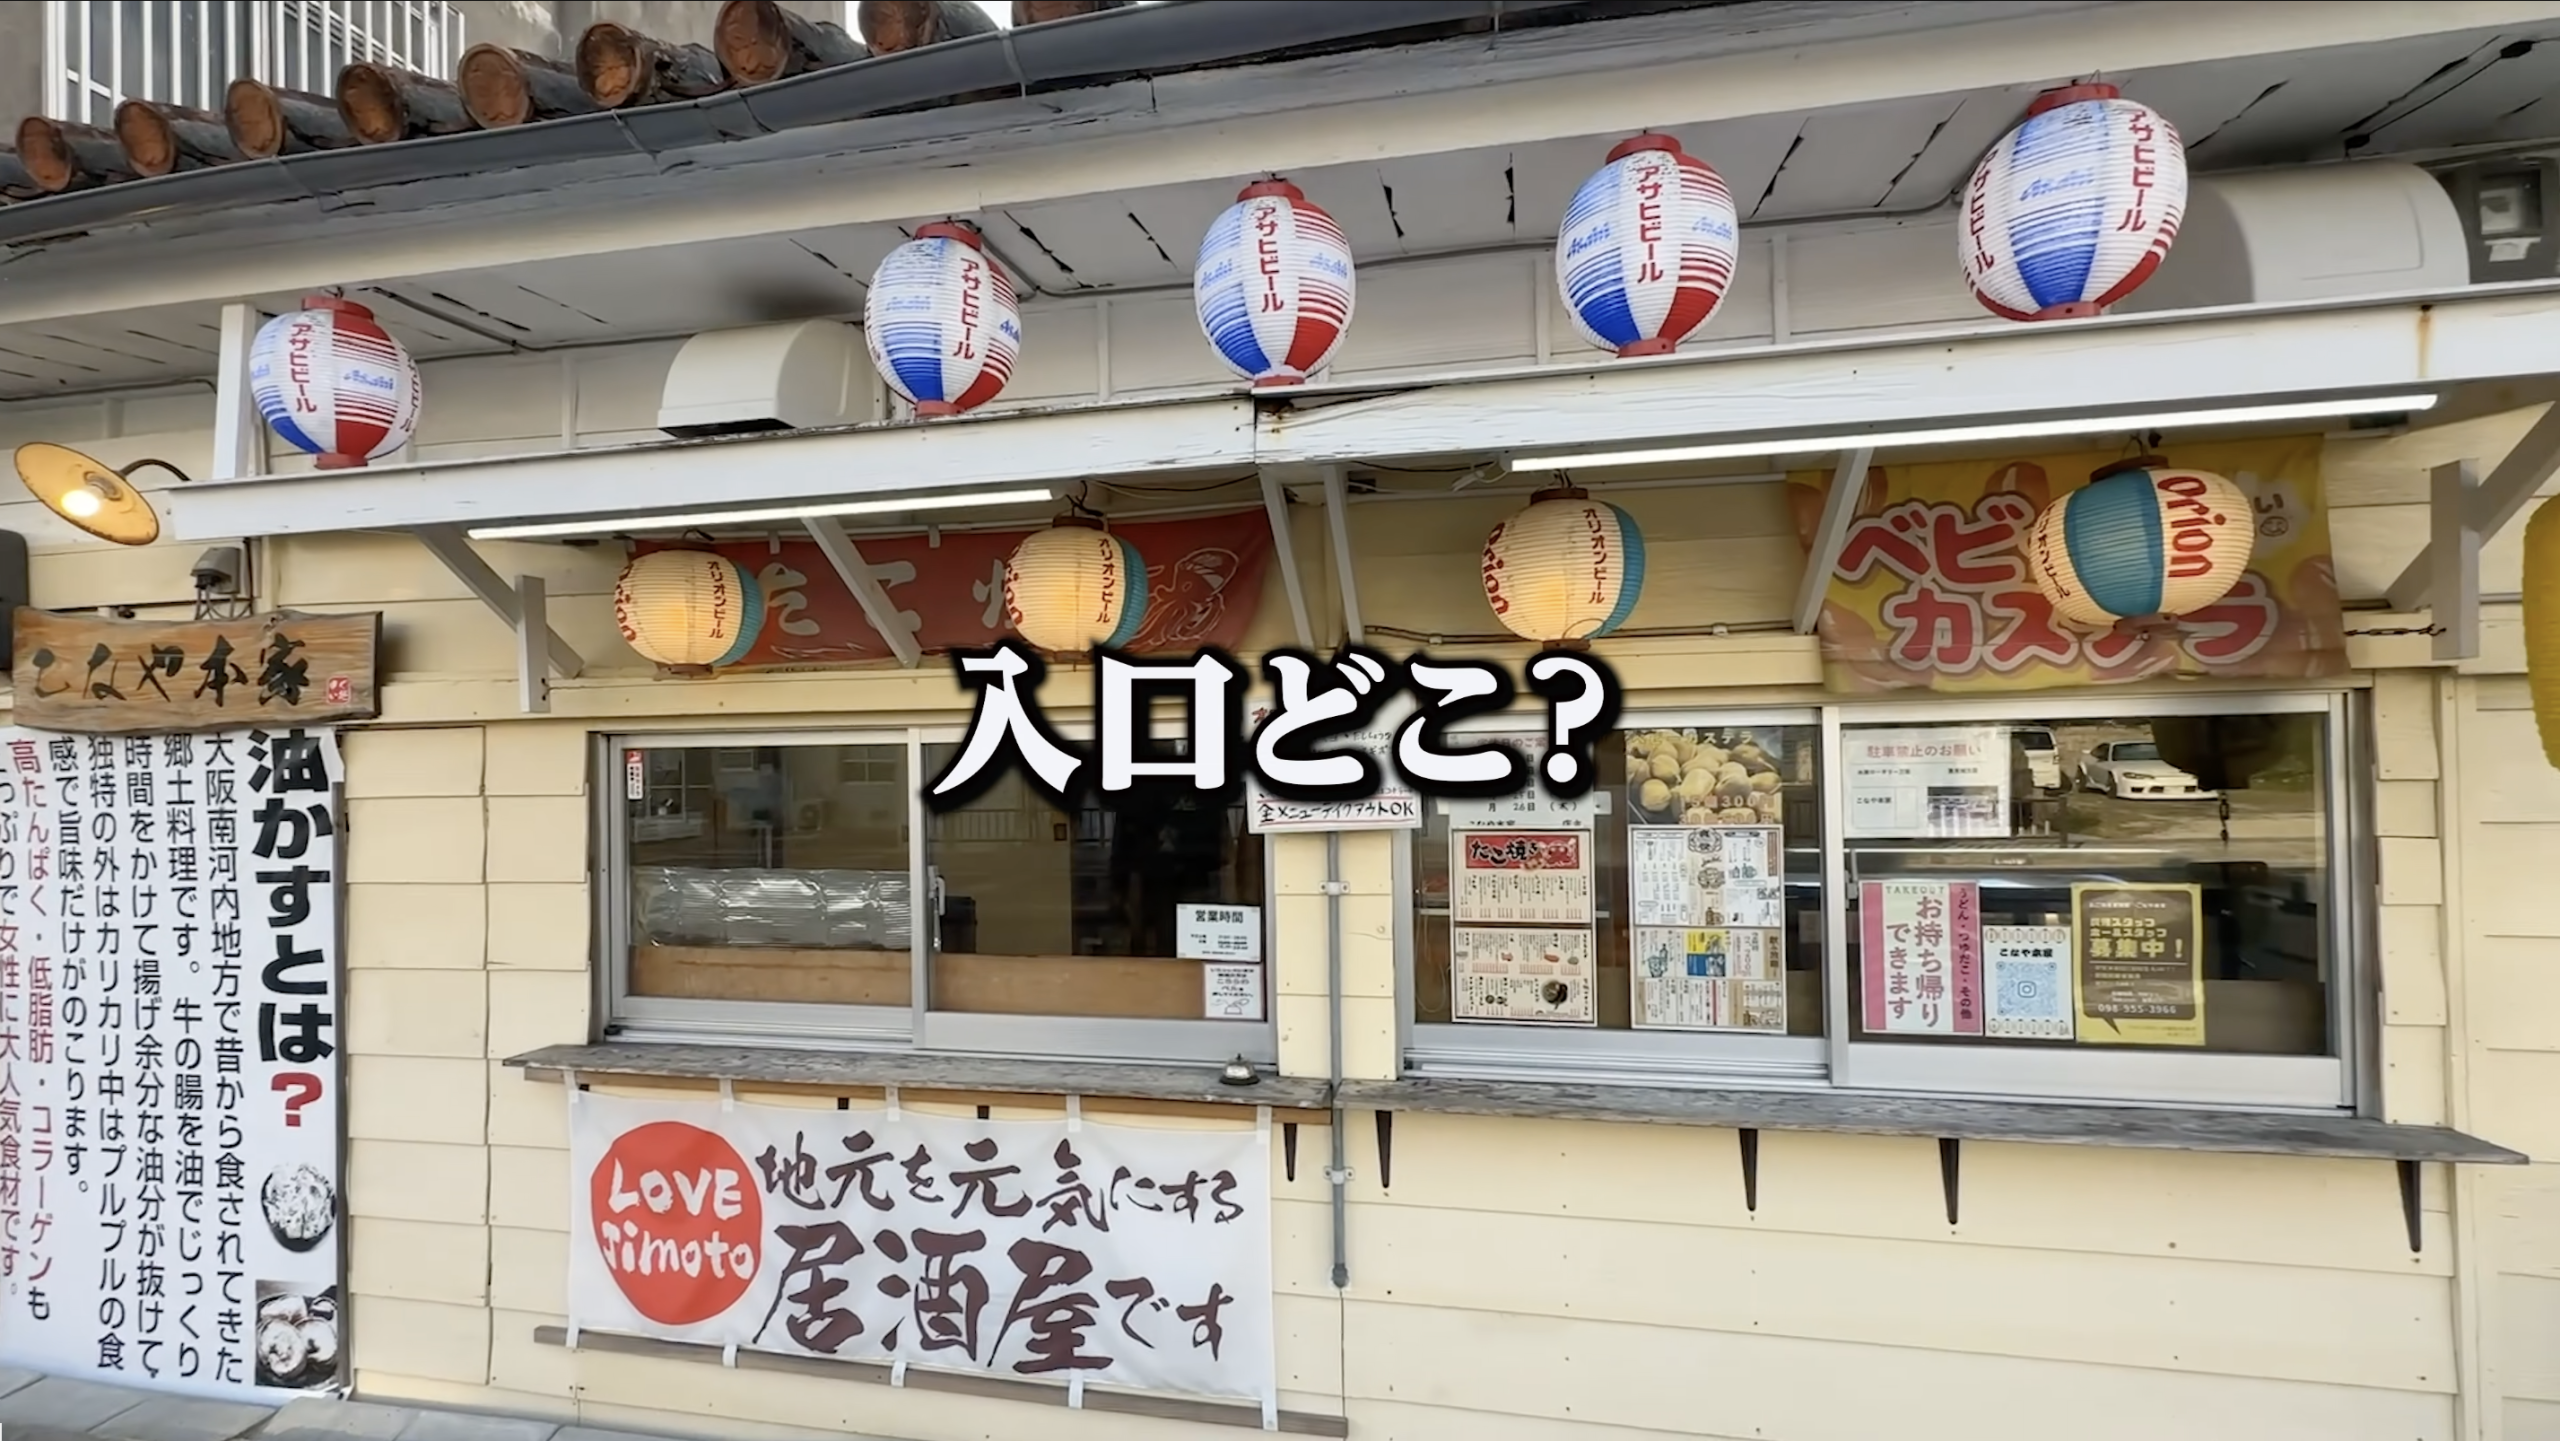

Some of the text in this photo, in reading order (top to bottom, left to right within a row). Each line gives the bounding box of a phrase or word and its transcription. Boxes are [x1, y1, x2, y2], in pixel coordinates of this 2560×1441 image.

[2116, 108, 2155, 232] アサヒビール
[1254, 206, 1284, 313] アサヒビール
[1636, 164, 1664, 283] アサヒビール
[952, 257, 982, 360] アサヒビール
[288, 323, 317, 413] アサヒビール
[1096, 538, 1116, 624] オリオンビール
[1582, 508, 1608, 604] オリオンビール
[1837, 502, 2027, 584] ベビ
[707, 560, 728, 639] オリオンビール
[31, 632, 310, 708] こなや本家
[1866, 743, 1981, 759] 駐車禁止のお願い
[1470, 838, 1539, 866] たこ焼き
[1886, 885, 1946, 895] TAKEOUT
[48, 736, 89, 1194] 感で旨味だけがのこります。
[247, 728, 336, 1127] 油かすとは?
[1195, 909, 1244, 924] 営業時間
[1913, 895, 1945, 1028] お持ち帰り
[1999, 948, 2054, 958] こなや本家
[1885, 922, 1913, 1020] できます
[0, 767, 23, 1296] っぷりで女性に大人気食材です。
[6, 738, 54, 1321] 高たんぱく・低脂肪・コラーゲンも
[87, 734, 128, 1372] 独特の外はカリカリ中はプルプルの食
[124, 734, 167, 1380] 時間をかけて揚げ余分な油分が抜けて
[162, 732, 206, 1378] 郷土料理です。牛の腸を油でじっくり
[203, 734, 246, 1384] 大阪南河内地方で昔から食されてきた
[608, 1156, 743, 1221] LOVE
[754, 1129, 1245, 1233] 地元を元気にする
[751, 1219, 1234, 1374] 居酒屋です
